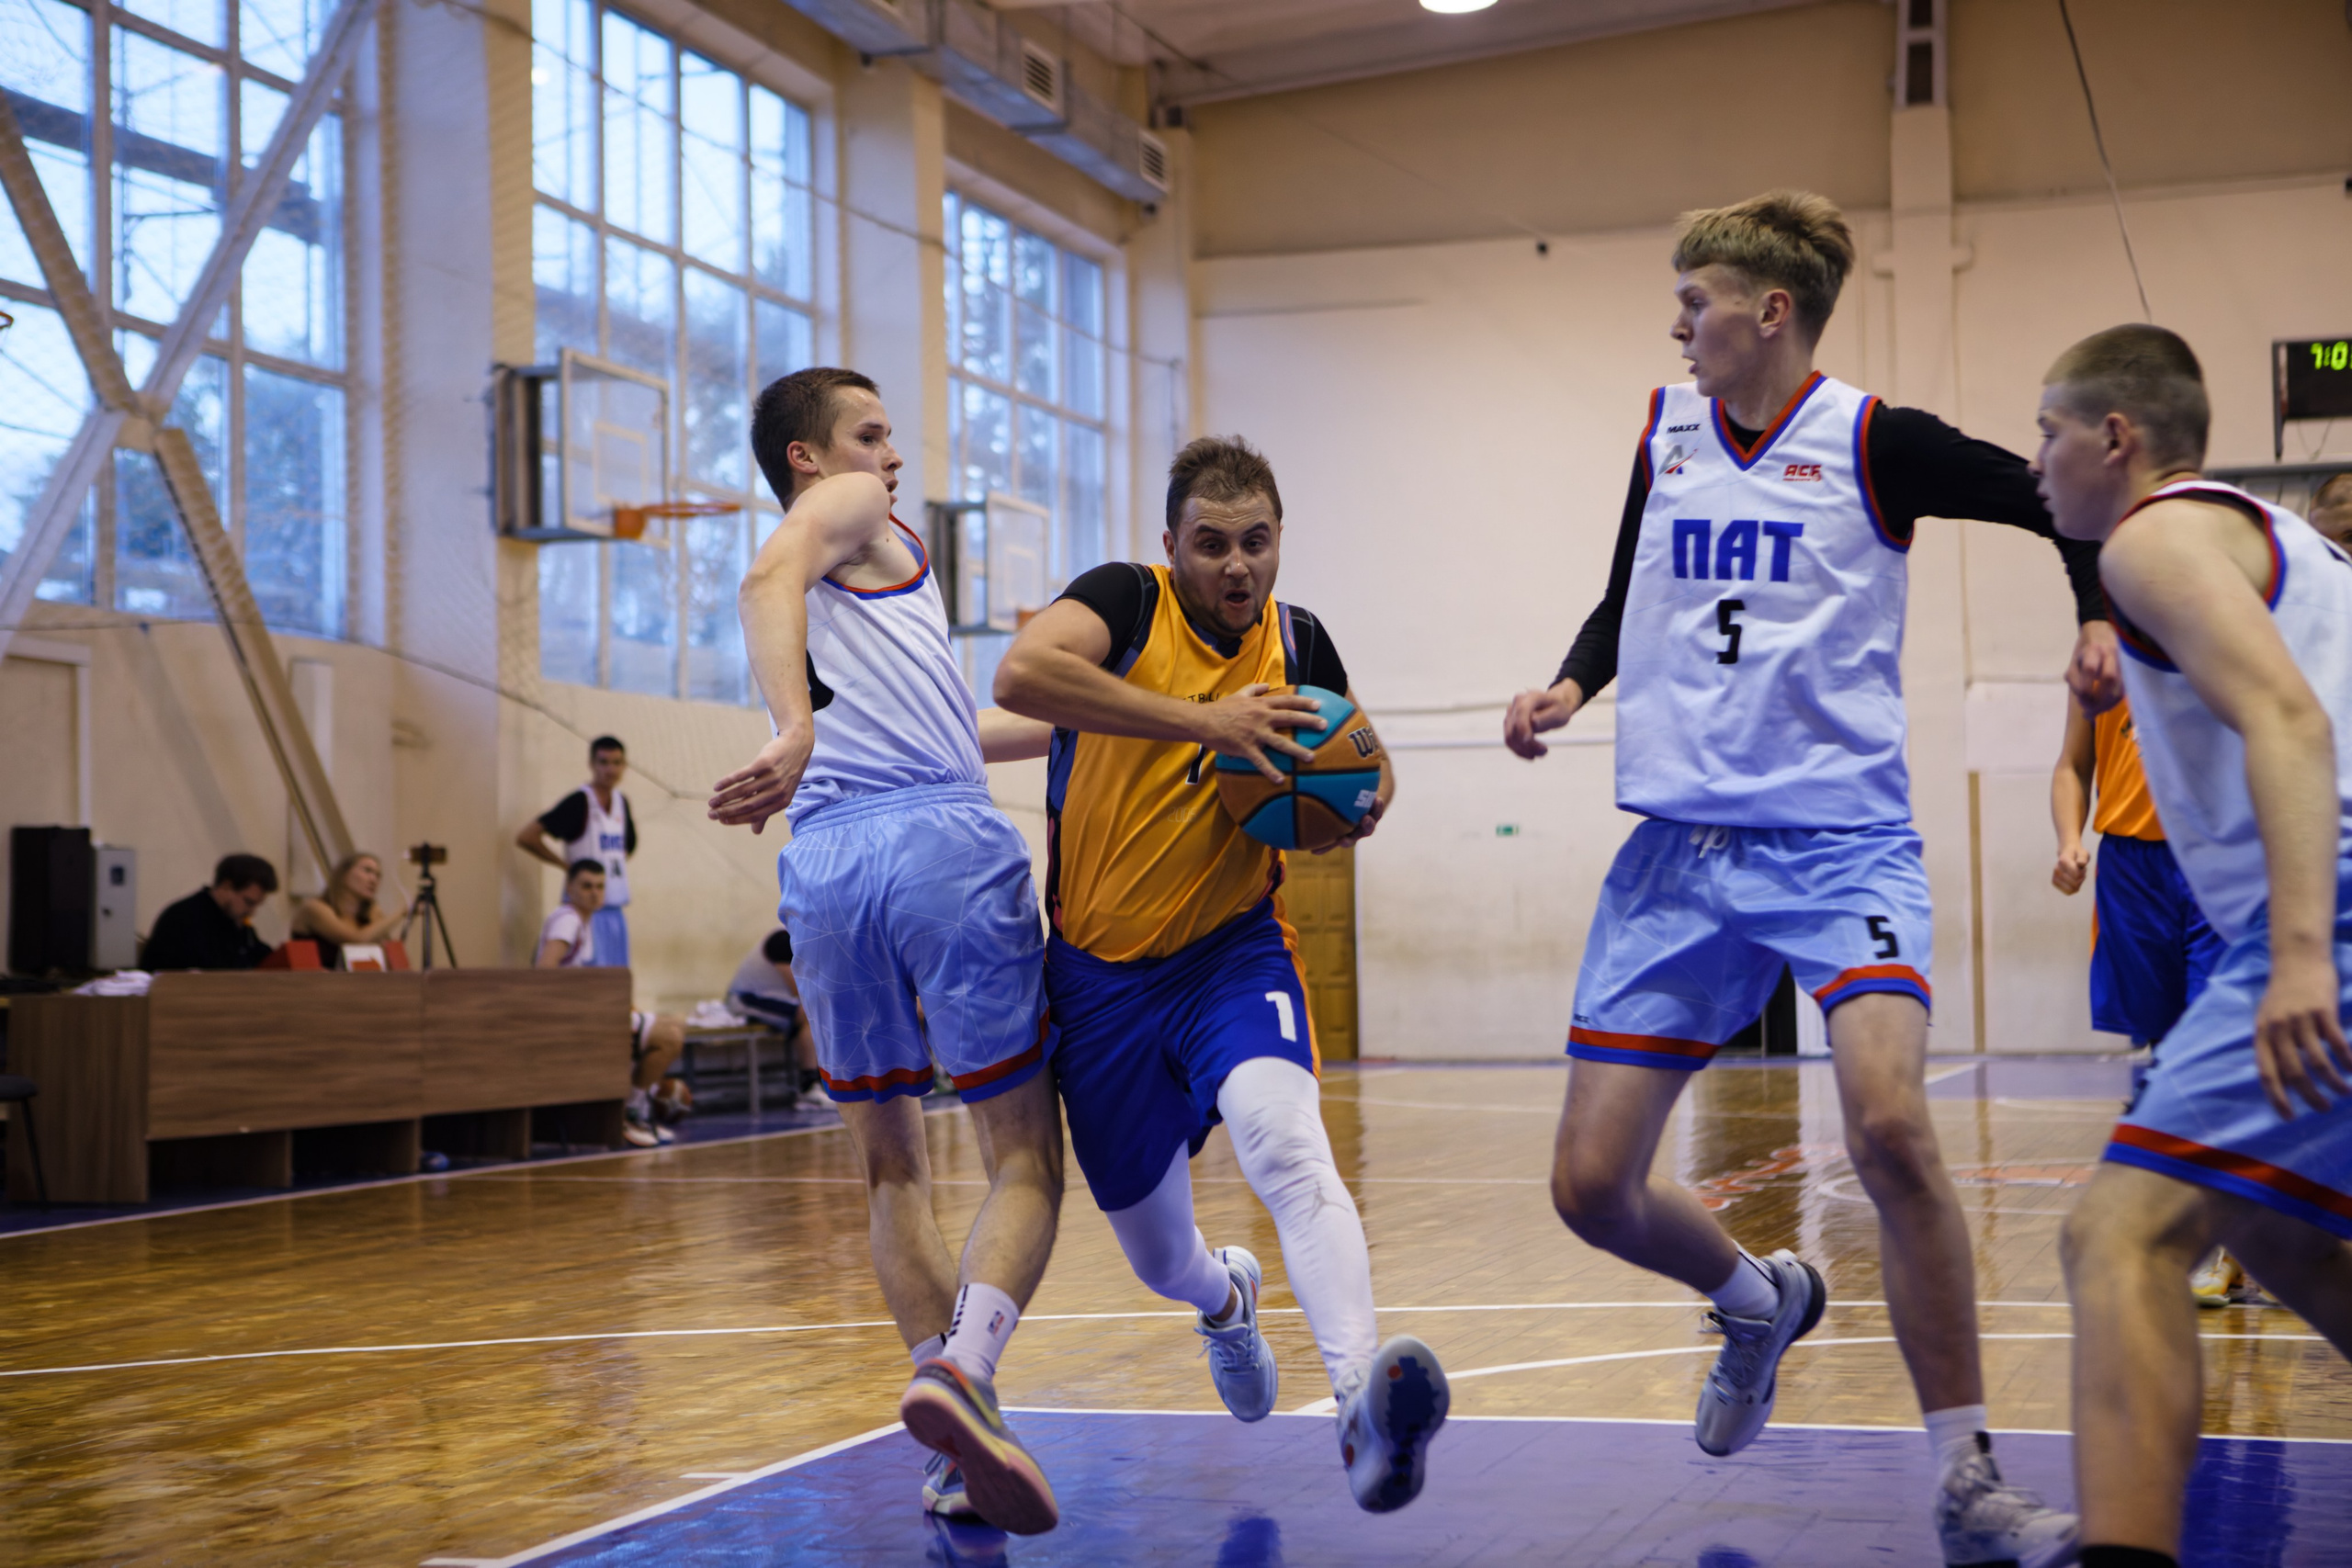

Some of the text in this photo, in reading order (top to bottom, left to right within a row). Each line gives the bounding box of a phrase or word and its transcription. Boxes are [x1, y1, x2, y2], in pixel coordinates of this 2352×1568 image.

[1667, 423, 1701, 434] MAXX
[1672, 519, 1804, 582] ПАТ
[1716, 599, 1746, 664] 5
[1864, 915, 1899, 960] 5
[1265, 991, 1297, 1043] 1
